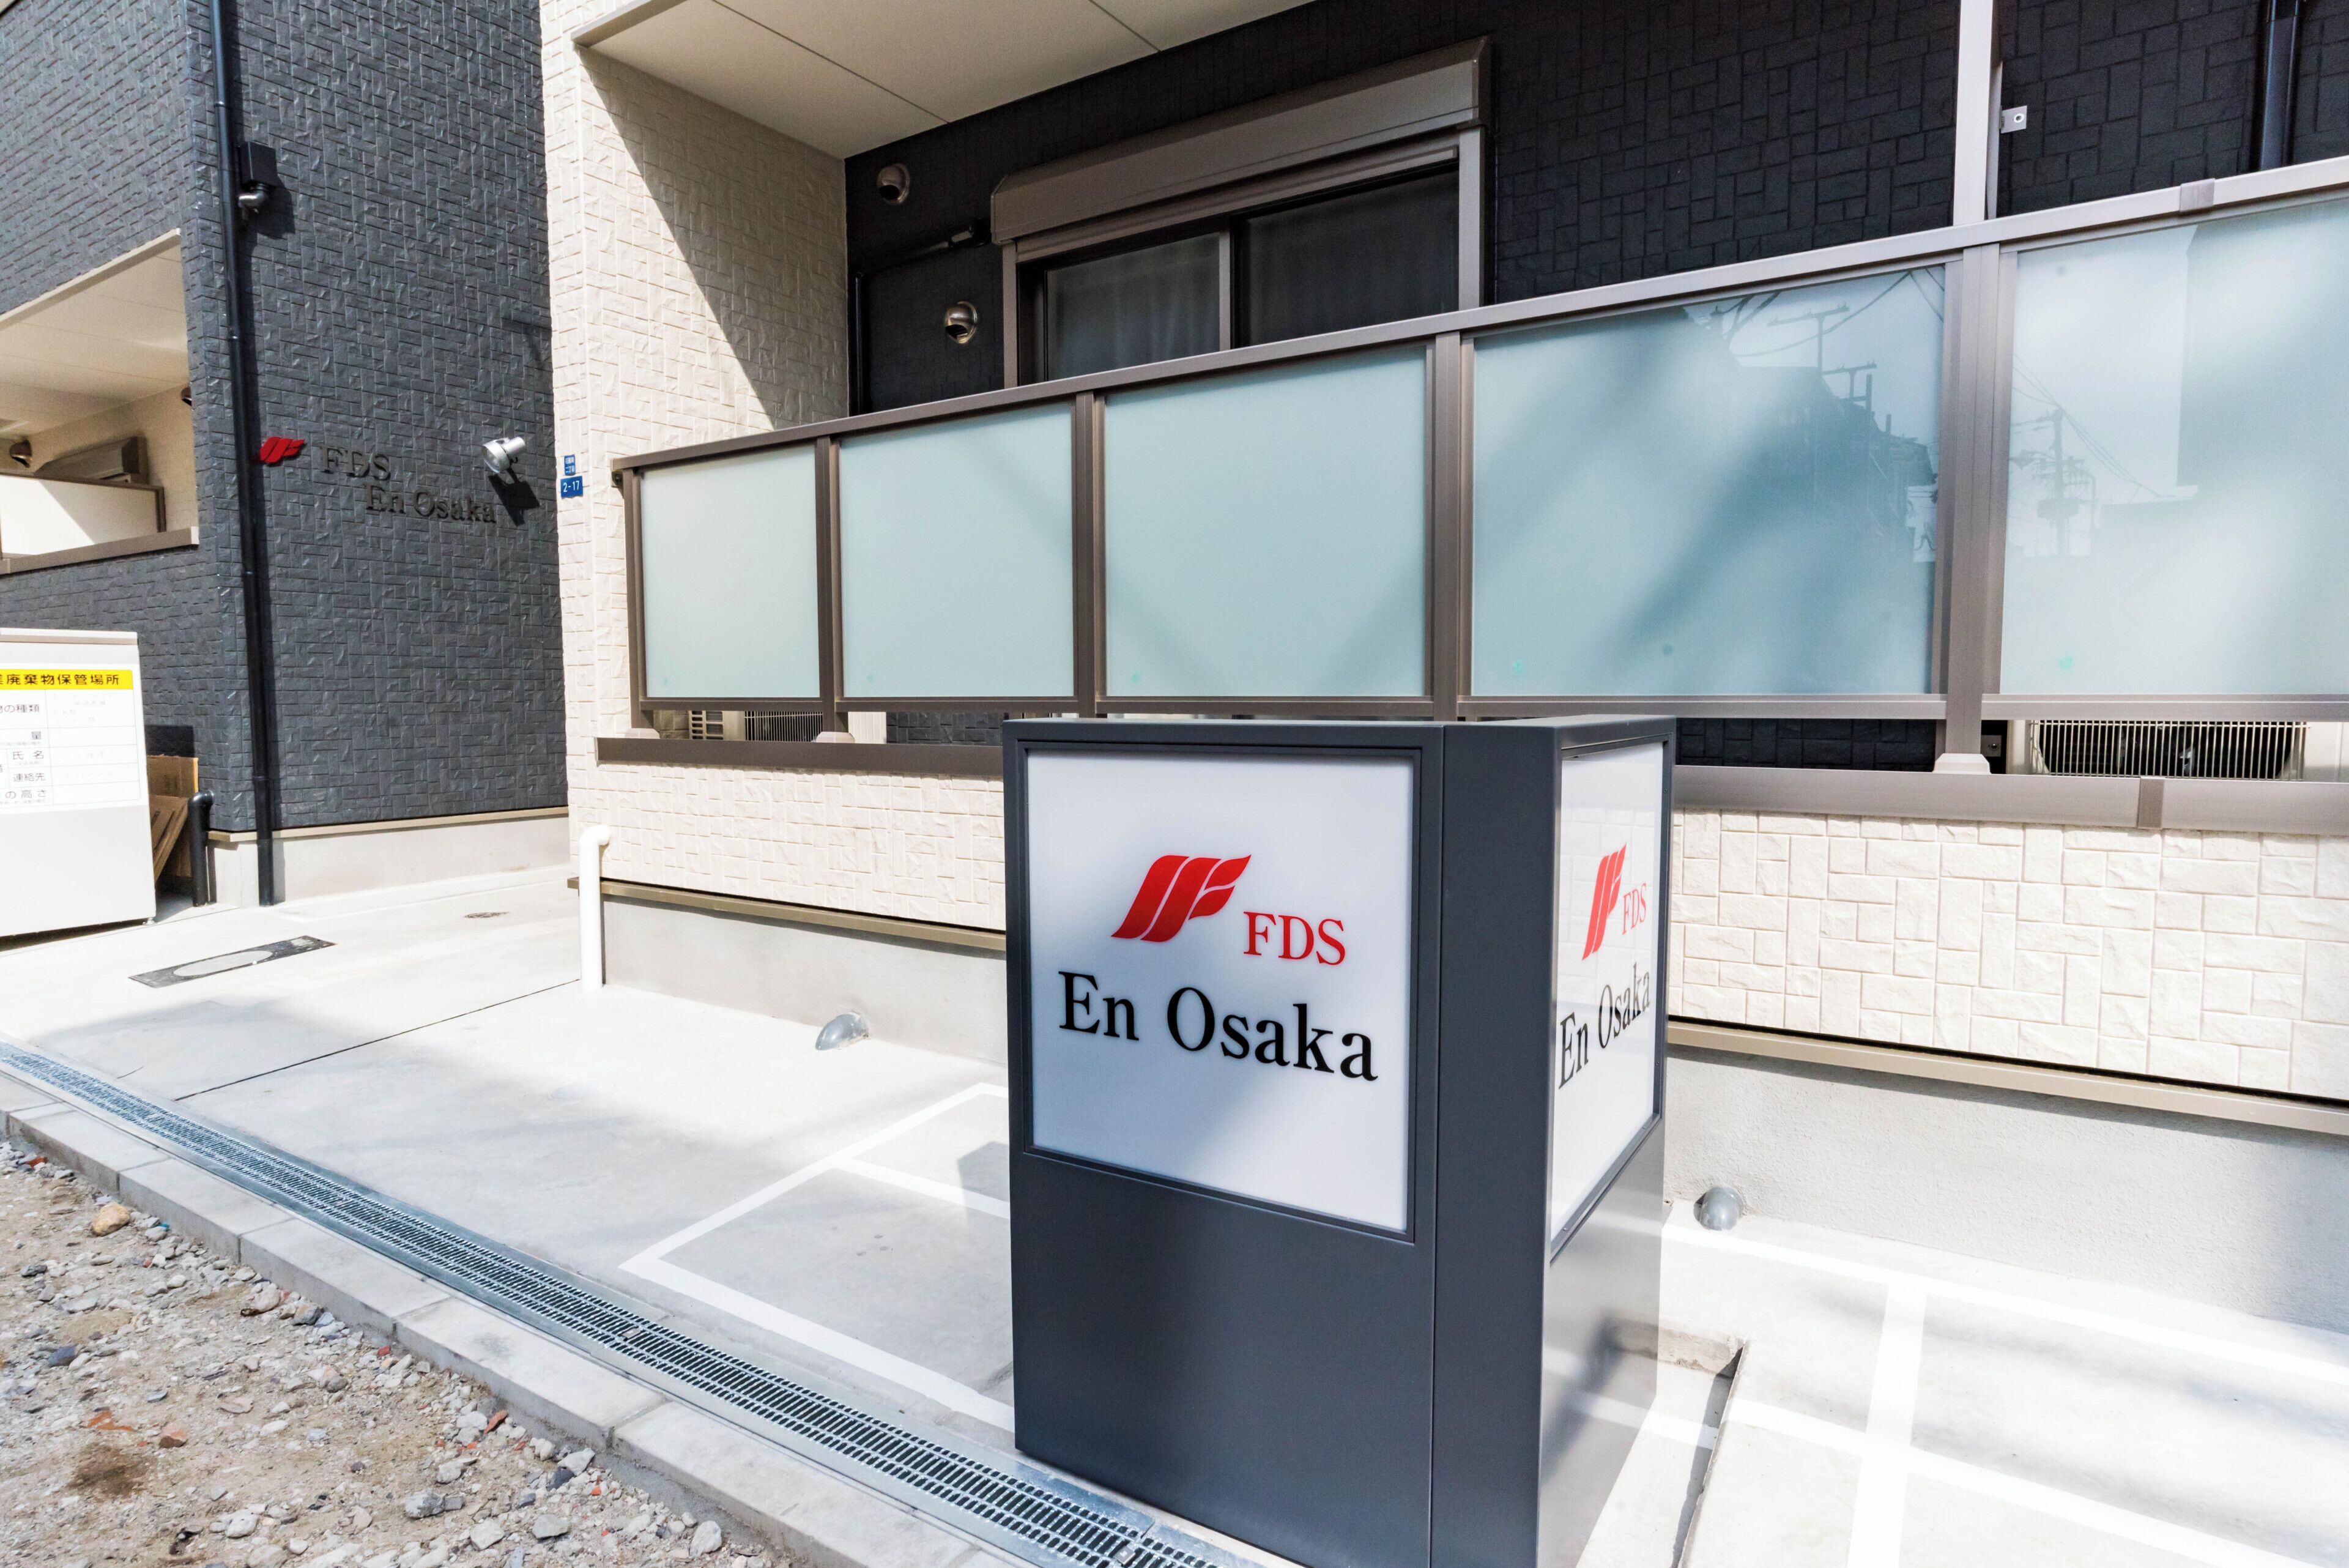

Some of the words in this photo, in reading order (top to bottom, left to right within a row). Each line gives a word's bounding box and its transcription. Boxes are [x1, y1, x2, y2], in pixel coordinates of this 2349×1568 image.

[319, 445, 391, 481] FDS
[365, 483, 405, 514] En
[414, 489, 497, 523] Osaka
[563, 480, 579, 492] 2-17
[0, 674, 120, 686] 廃棄物保管場所
[0, 704, 40, 713] の種類
[1622, 883, 1647, 935] FDS
[1243, 911, 1346, 965] FDS
[1058, 971, 1140, 1041] En
[1167, 987, 1378, 1082] Osaka
[1558, 1012, 1589, 1089] En
[1598, 962, 1650, 1049] Osaka
